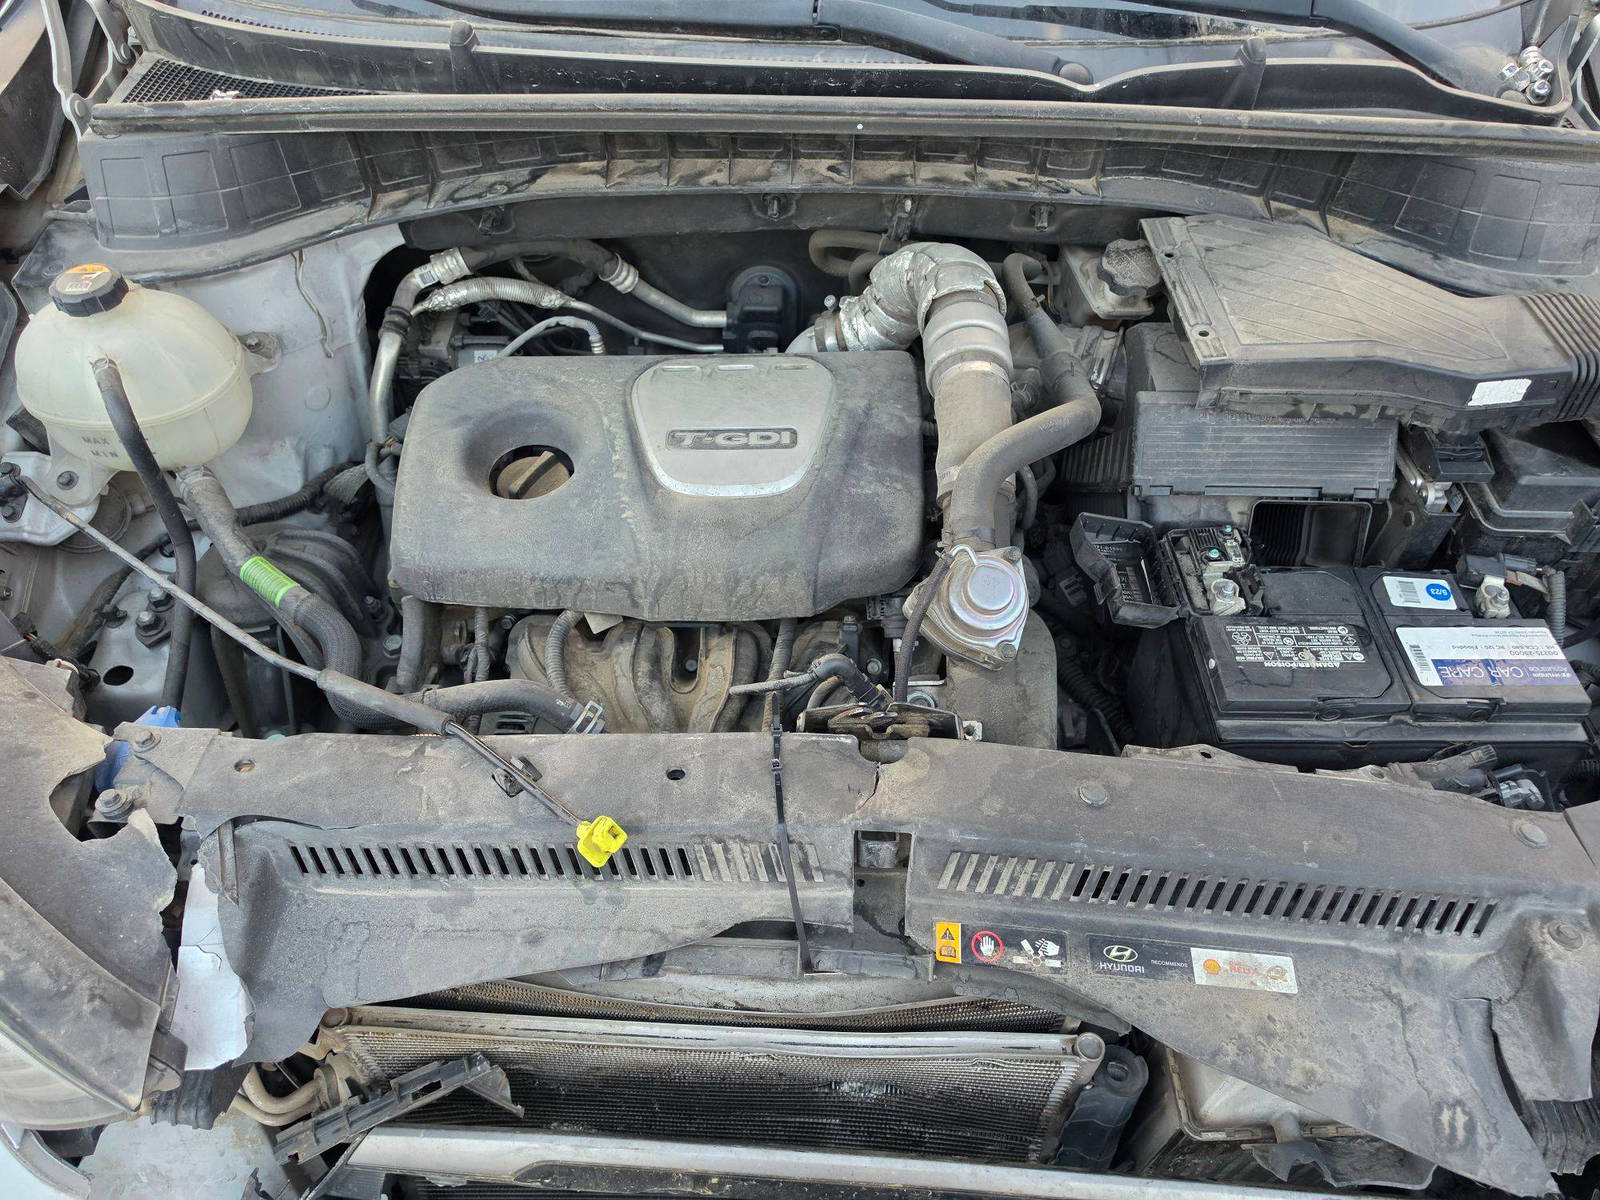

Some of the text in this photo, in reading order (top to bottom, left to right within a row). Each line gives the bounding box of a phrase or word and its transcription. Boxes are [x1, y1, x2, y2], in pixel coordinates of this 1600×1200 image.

[81, 436, 110, 445] MAX
[675, 431, 791, 449] T-GDI
[90, 450, 119, 458] MIN
[1441, 666, 1524, 678] CAR CARE
[1099, 961, 1145, 974] HYUNDAI
[1150, 959, 1188, 968] RECOMMENDS
